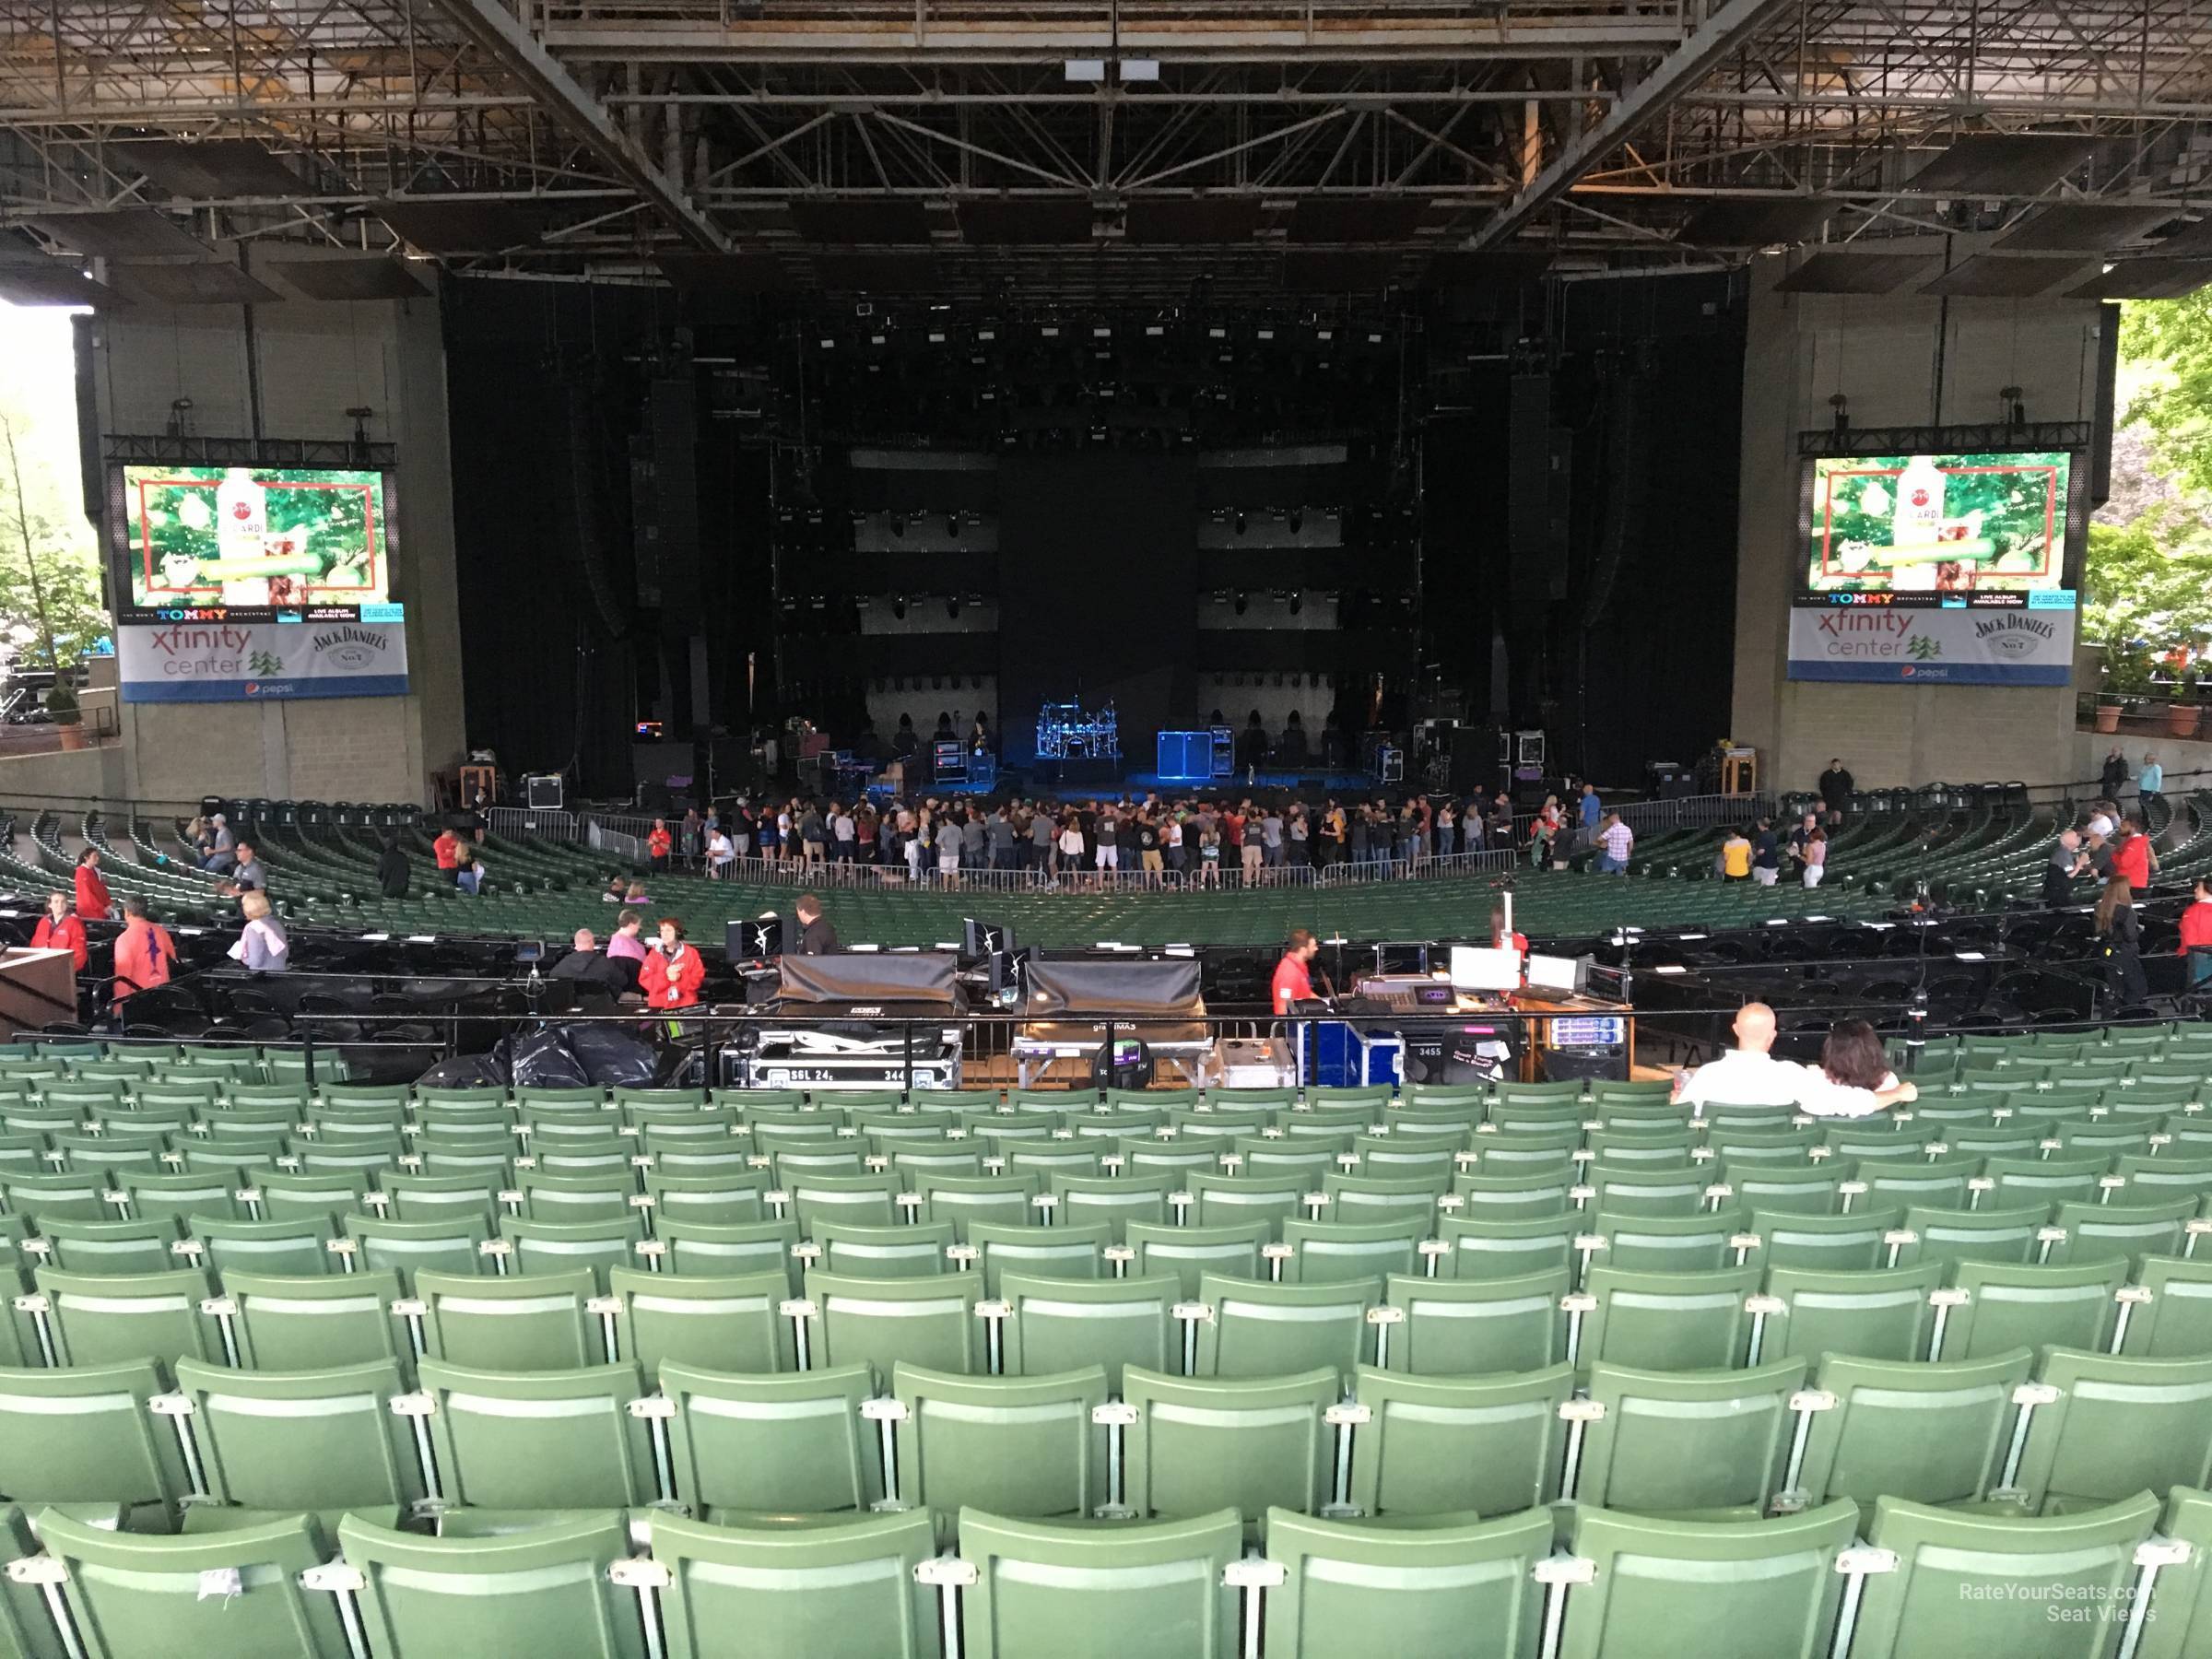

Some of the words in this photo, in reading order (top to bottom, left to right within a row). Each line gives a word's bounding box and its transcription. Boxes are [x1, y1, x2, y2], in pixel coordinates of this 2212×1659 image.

[1829, 594, 1894, 604] TOMMY
[157, 609, 227, 620] TOMMY
[1818, 608, 1914, 638] xfinity
[1976, 618, 2005, 639] JACK
[2007, 613, 2055, 640] DANIEL'S
[151, 625, 252, 655] xfinity
[313, 629, 341, 652] JACK
[343, 626, 389, 651] DANIEL'S
[1827, 639, 1902, 656] center
[163, 655, 243, 675] center
[1917, 667, 1948, 679] pepsi
[262, 683, 294, 694] pepsi
[1093, 1024, 1136, 1032] graMA3
[1419, 1048, 1441, 1056] 3455
